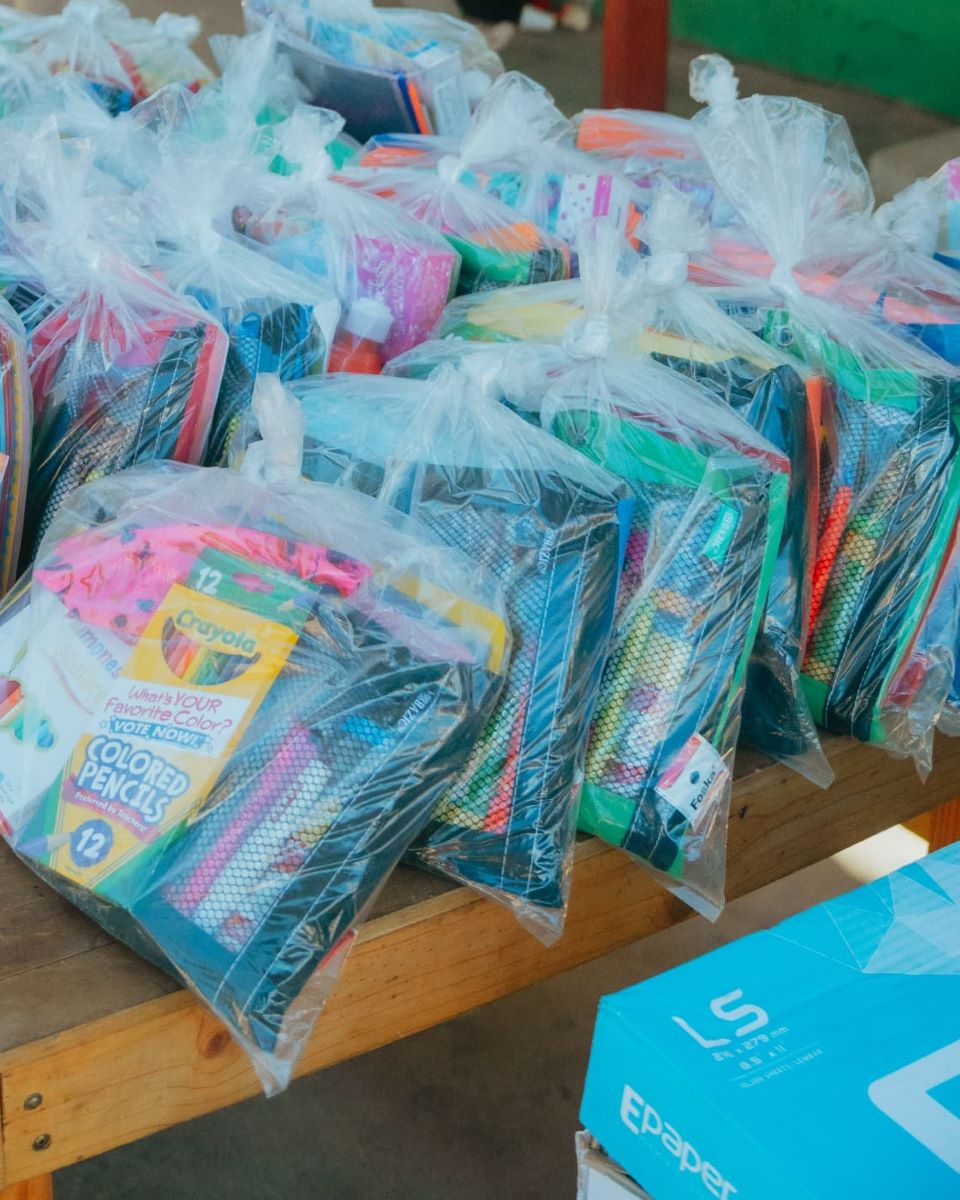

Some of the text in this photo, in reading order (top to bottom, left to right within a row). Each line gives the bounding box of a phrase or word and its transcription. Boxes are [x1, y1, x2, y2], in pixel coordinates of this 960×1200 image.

[195, 565, 222, 595] 12
[175, 608, 258, 656] Crayola
[104, 697, 233, 734] Favorite Color?
[128, 685, 223, 713] What's YOUR
[113, 720, 200, 747] VOTE NOW!
[86, 734, 189, 799] COLORED
[77, 760, 170, 824] PENCILS
[76, 828, 106, 859] 12
[742, 1034, 769, 1050] 279
[620, 1083, 738, 1200] Epaper
